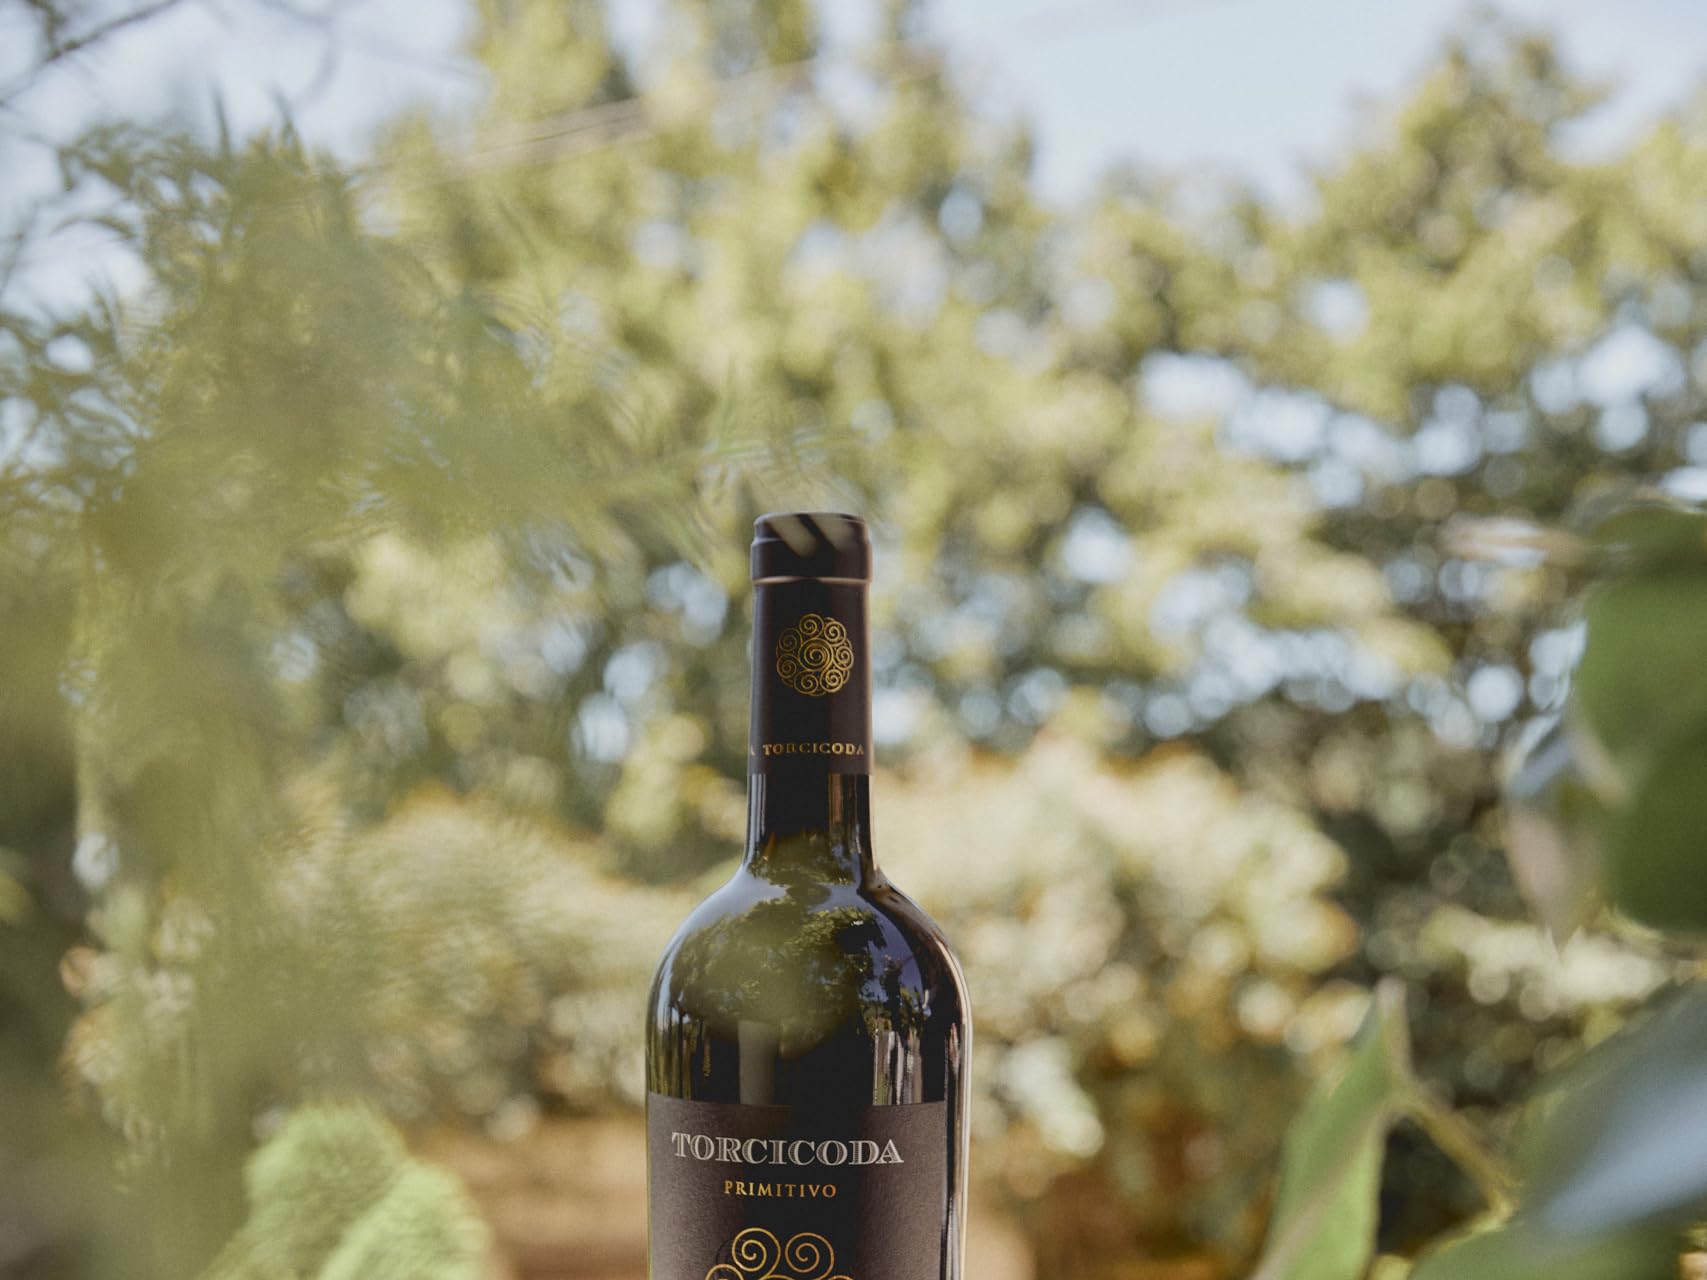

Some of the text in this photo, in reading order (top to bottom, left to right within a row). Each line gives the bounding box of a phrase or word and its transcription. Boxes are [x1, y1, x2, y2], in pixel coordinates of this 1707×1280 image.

[762, 743, 865, 757] TORCICODA
[671, 1131, 904, 1166] TORCICODA
[723, 1180, 837, 1198] PRIMITIVO
